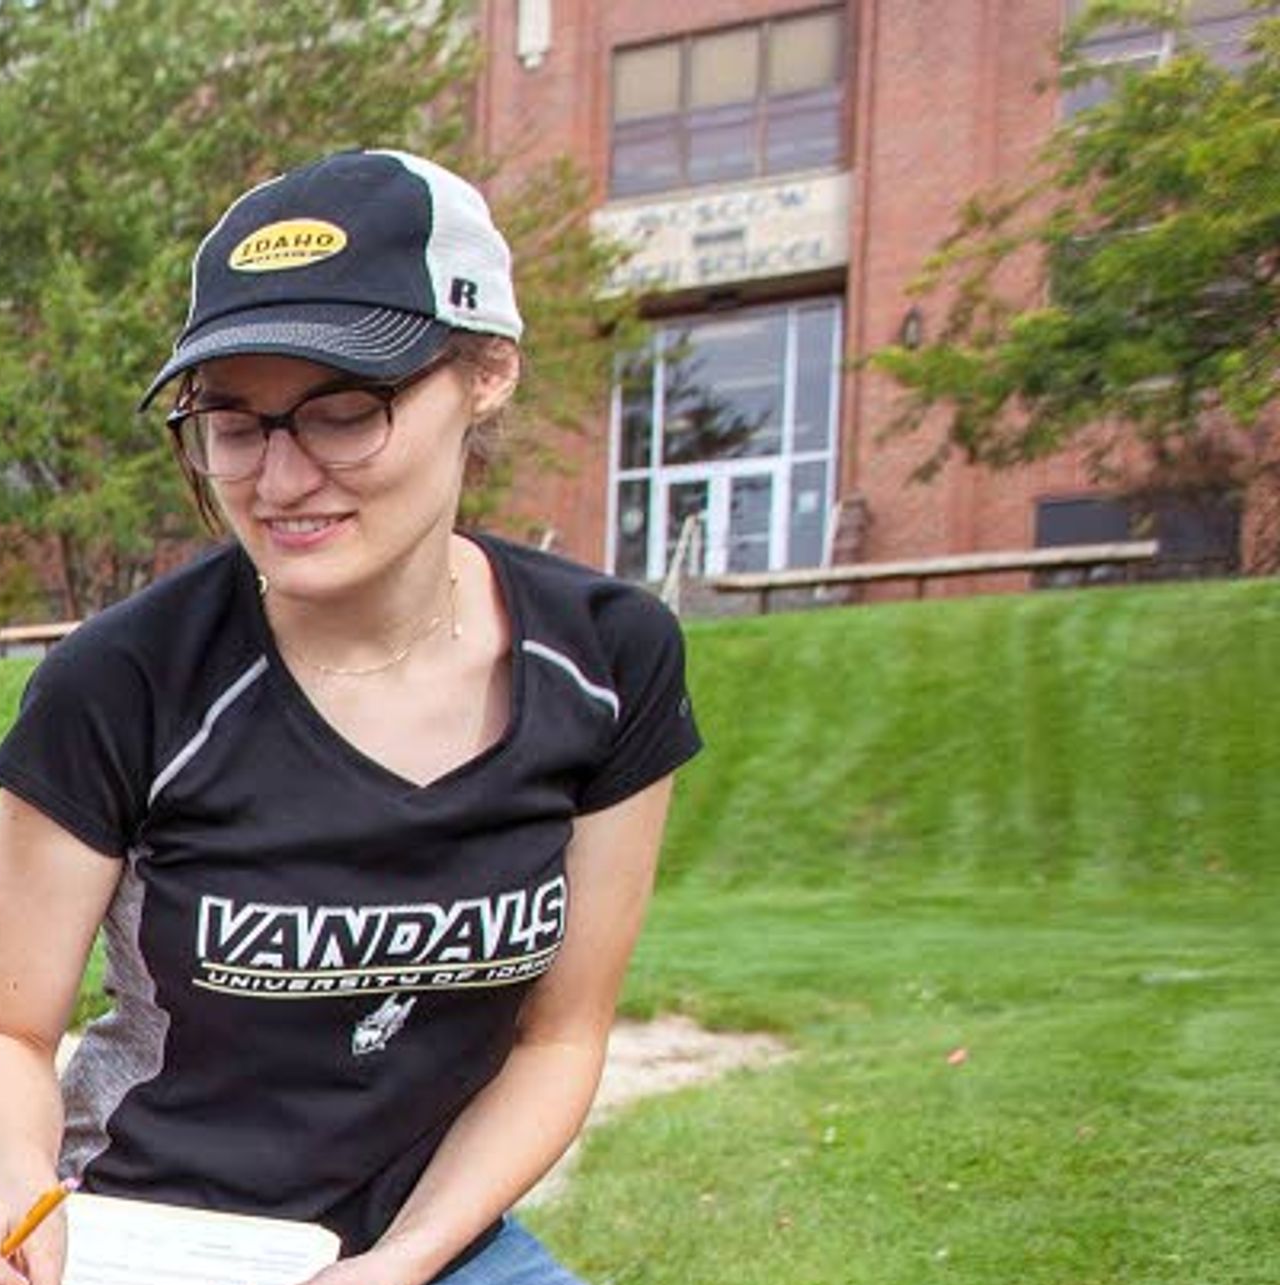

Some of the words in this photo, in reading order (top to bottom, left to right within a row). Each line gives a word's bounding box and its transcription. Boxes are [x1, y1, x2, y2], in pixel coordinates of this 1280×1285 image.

[242, 233, 335, 257] IDAHO
[450, 277, 478, 309] R
[207, 970, 422, 991] UNIVERSITY
[432, 970, 476, 985] OF
